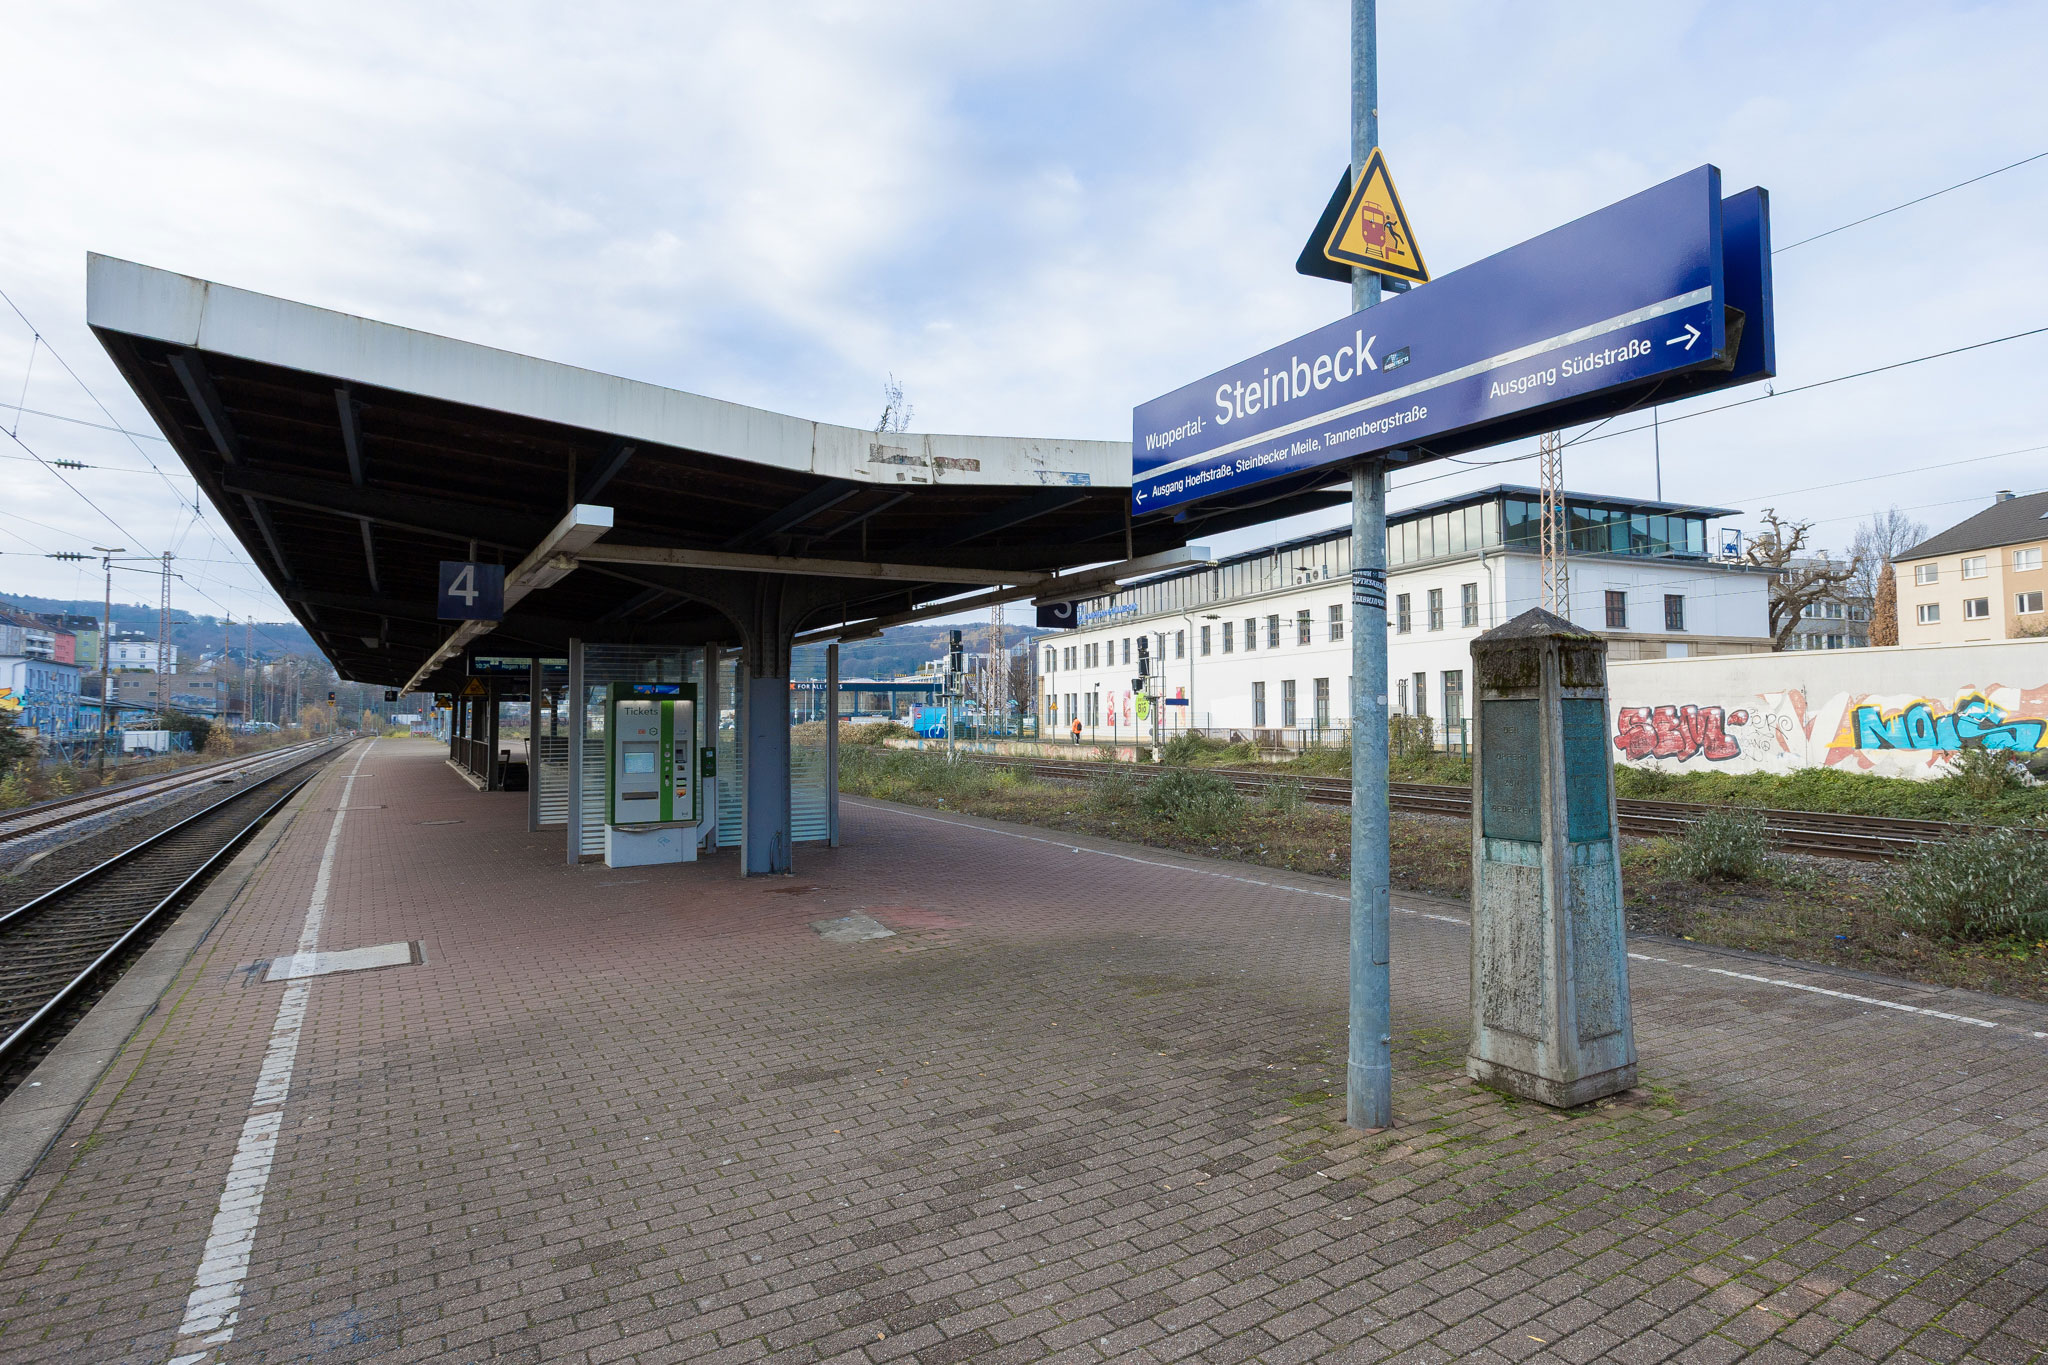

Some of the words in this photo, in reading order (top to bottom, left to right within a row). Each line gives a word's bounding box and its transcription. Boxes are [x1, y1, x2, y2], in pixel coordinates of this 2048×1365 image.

[1145, 415, 1207, 451] Wuppertal-
[1215, 329, 1378, 425] Steinbeck
[1490, 366, 1557, 399] Ausgang
[1561, 337, 1652, 378] Südstraße
[1151, 473, 1184, 498] Ausgang
[1185, 461, 1235, 487] Hoeftstraße,
[1235, 446, 1289, 474] Steinbecker
[1291, 438, 1322, 456] Meile,
[1324, 404, 1428, 447] Tannenbergstraße
[447, 564, 479, 606] 4
[624, 706, 659, 716] Tickets
